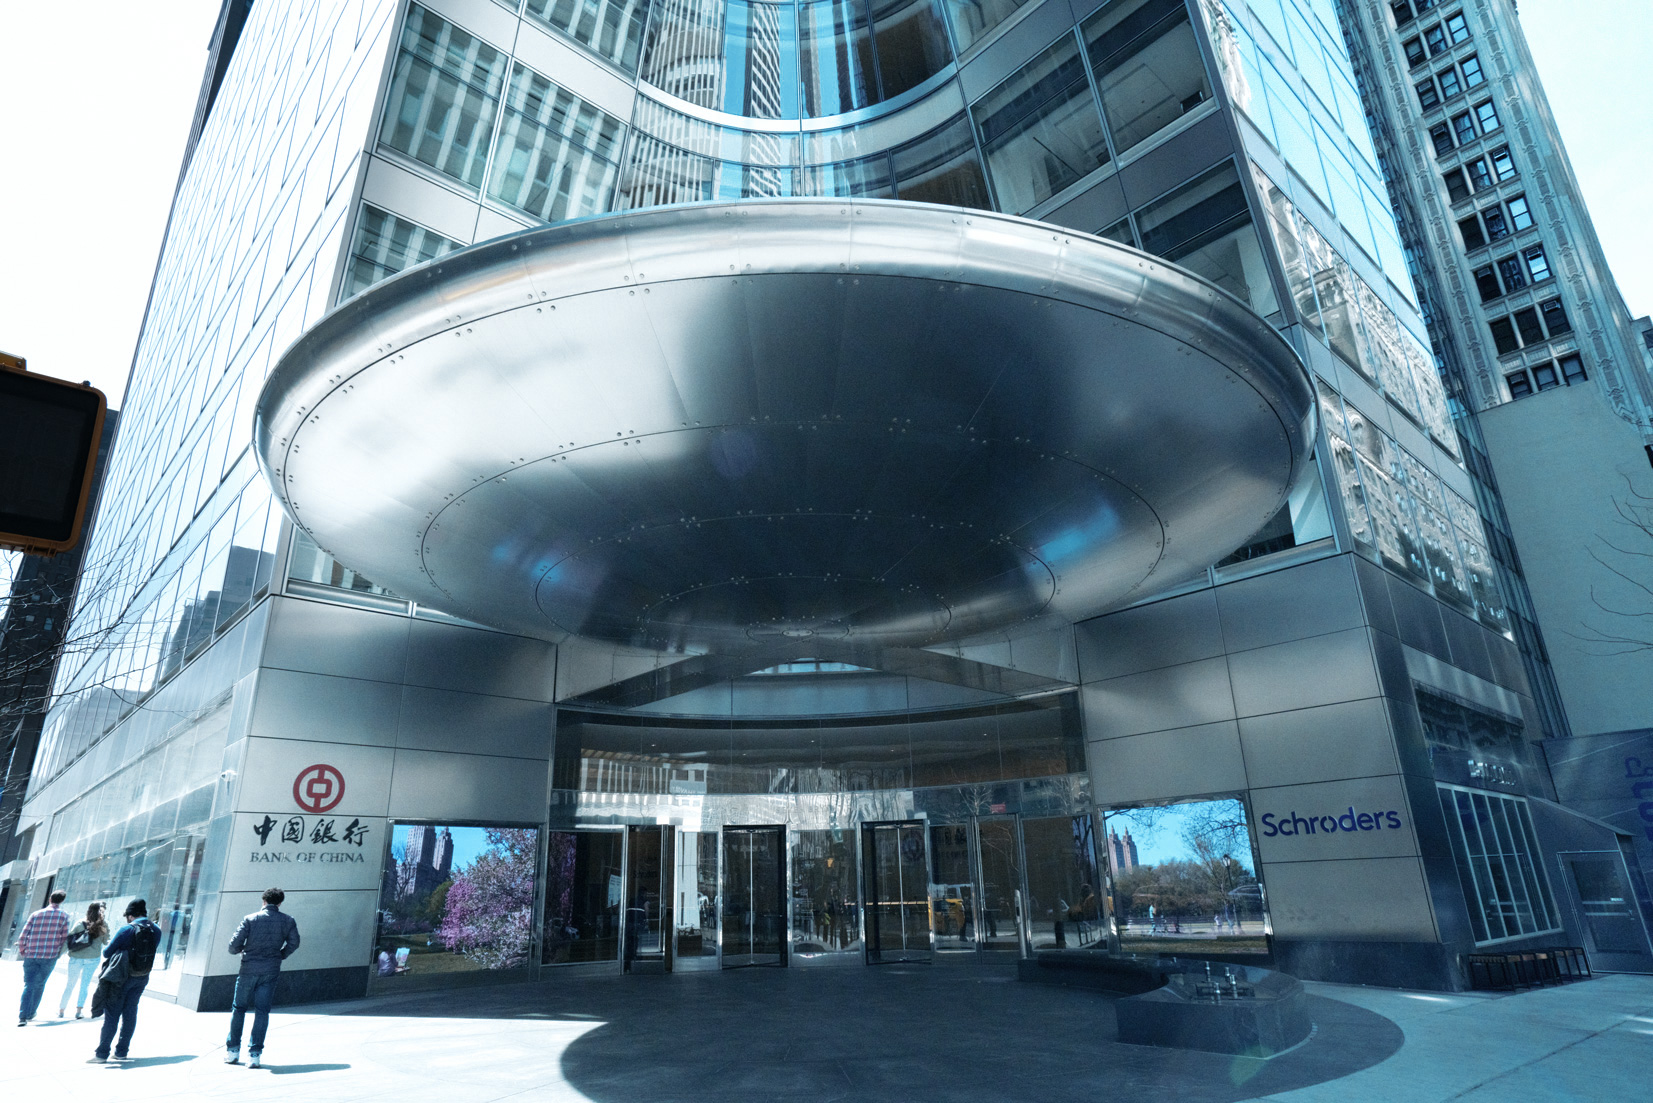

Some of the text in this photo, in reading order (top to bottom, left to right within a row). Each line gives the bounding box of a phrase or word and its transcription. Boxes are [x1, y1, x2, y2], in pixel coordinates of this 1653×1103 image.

[253, 815, 369, 847] 中國銀行
[1261, 805, 1402, 838] Schroders
[249, 852, 365, 863] BANK OF CHINA
